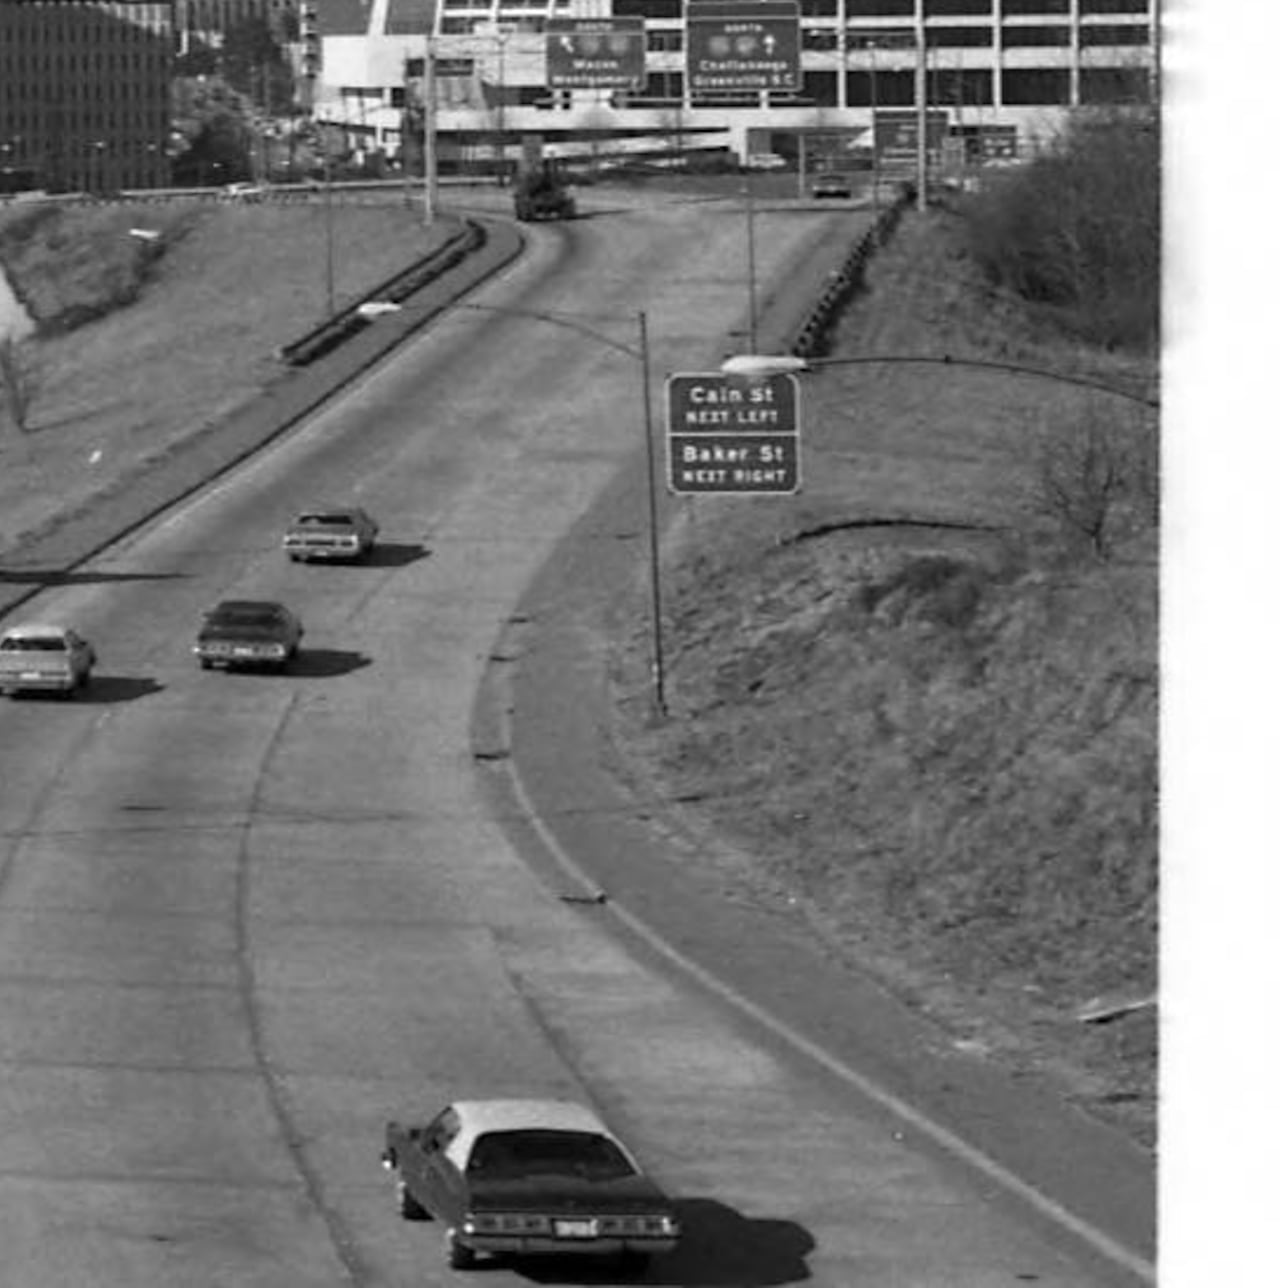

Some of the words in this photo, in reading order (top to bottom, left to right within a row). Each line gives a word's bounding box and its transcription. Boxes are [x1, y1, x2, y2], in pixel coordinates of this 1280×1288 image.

[689, 386, 741, 403] Cain
[748, 387, 774, 403] St
[685, 409, 729, 424] NEXT
[737, 409, 778, 424] LEFT
[682, 444, 748, 463] Baker
[760, 444, 783, 463] St
[682, 469, 727, 483] NEXT
[733, 469, 786, 483] RIGHT
